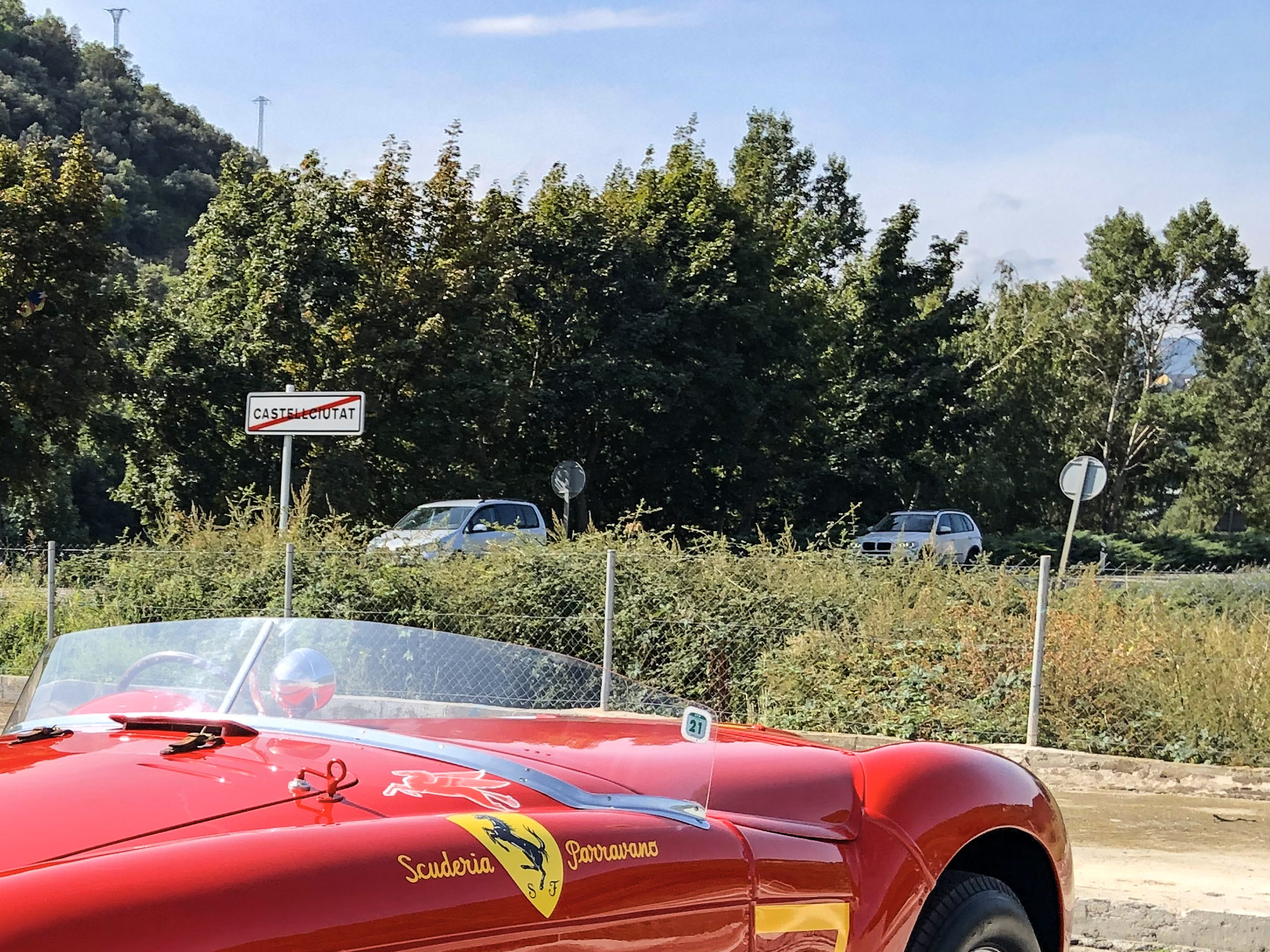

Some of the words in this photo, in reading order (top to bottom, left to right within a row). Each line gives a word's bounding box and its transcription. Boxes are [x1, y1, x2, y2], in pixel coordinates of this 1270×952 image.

[253, 408, 356, 420] CASTELLCIUTAT
[689, 719, 703, 735] 21
[397, 852, 495, 884] Scuderia
[564, 840, 659, 871] Parravano
[527, 883, 537, 899] S
[548, 880, 560, 897] F
